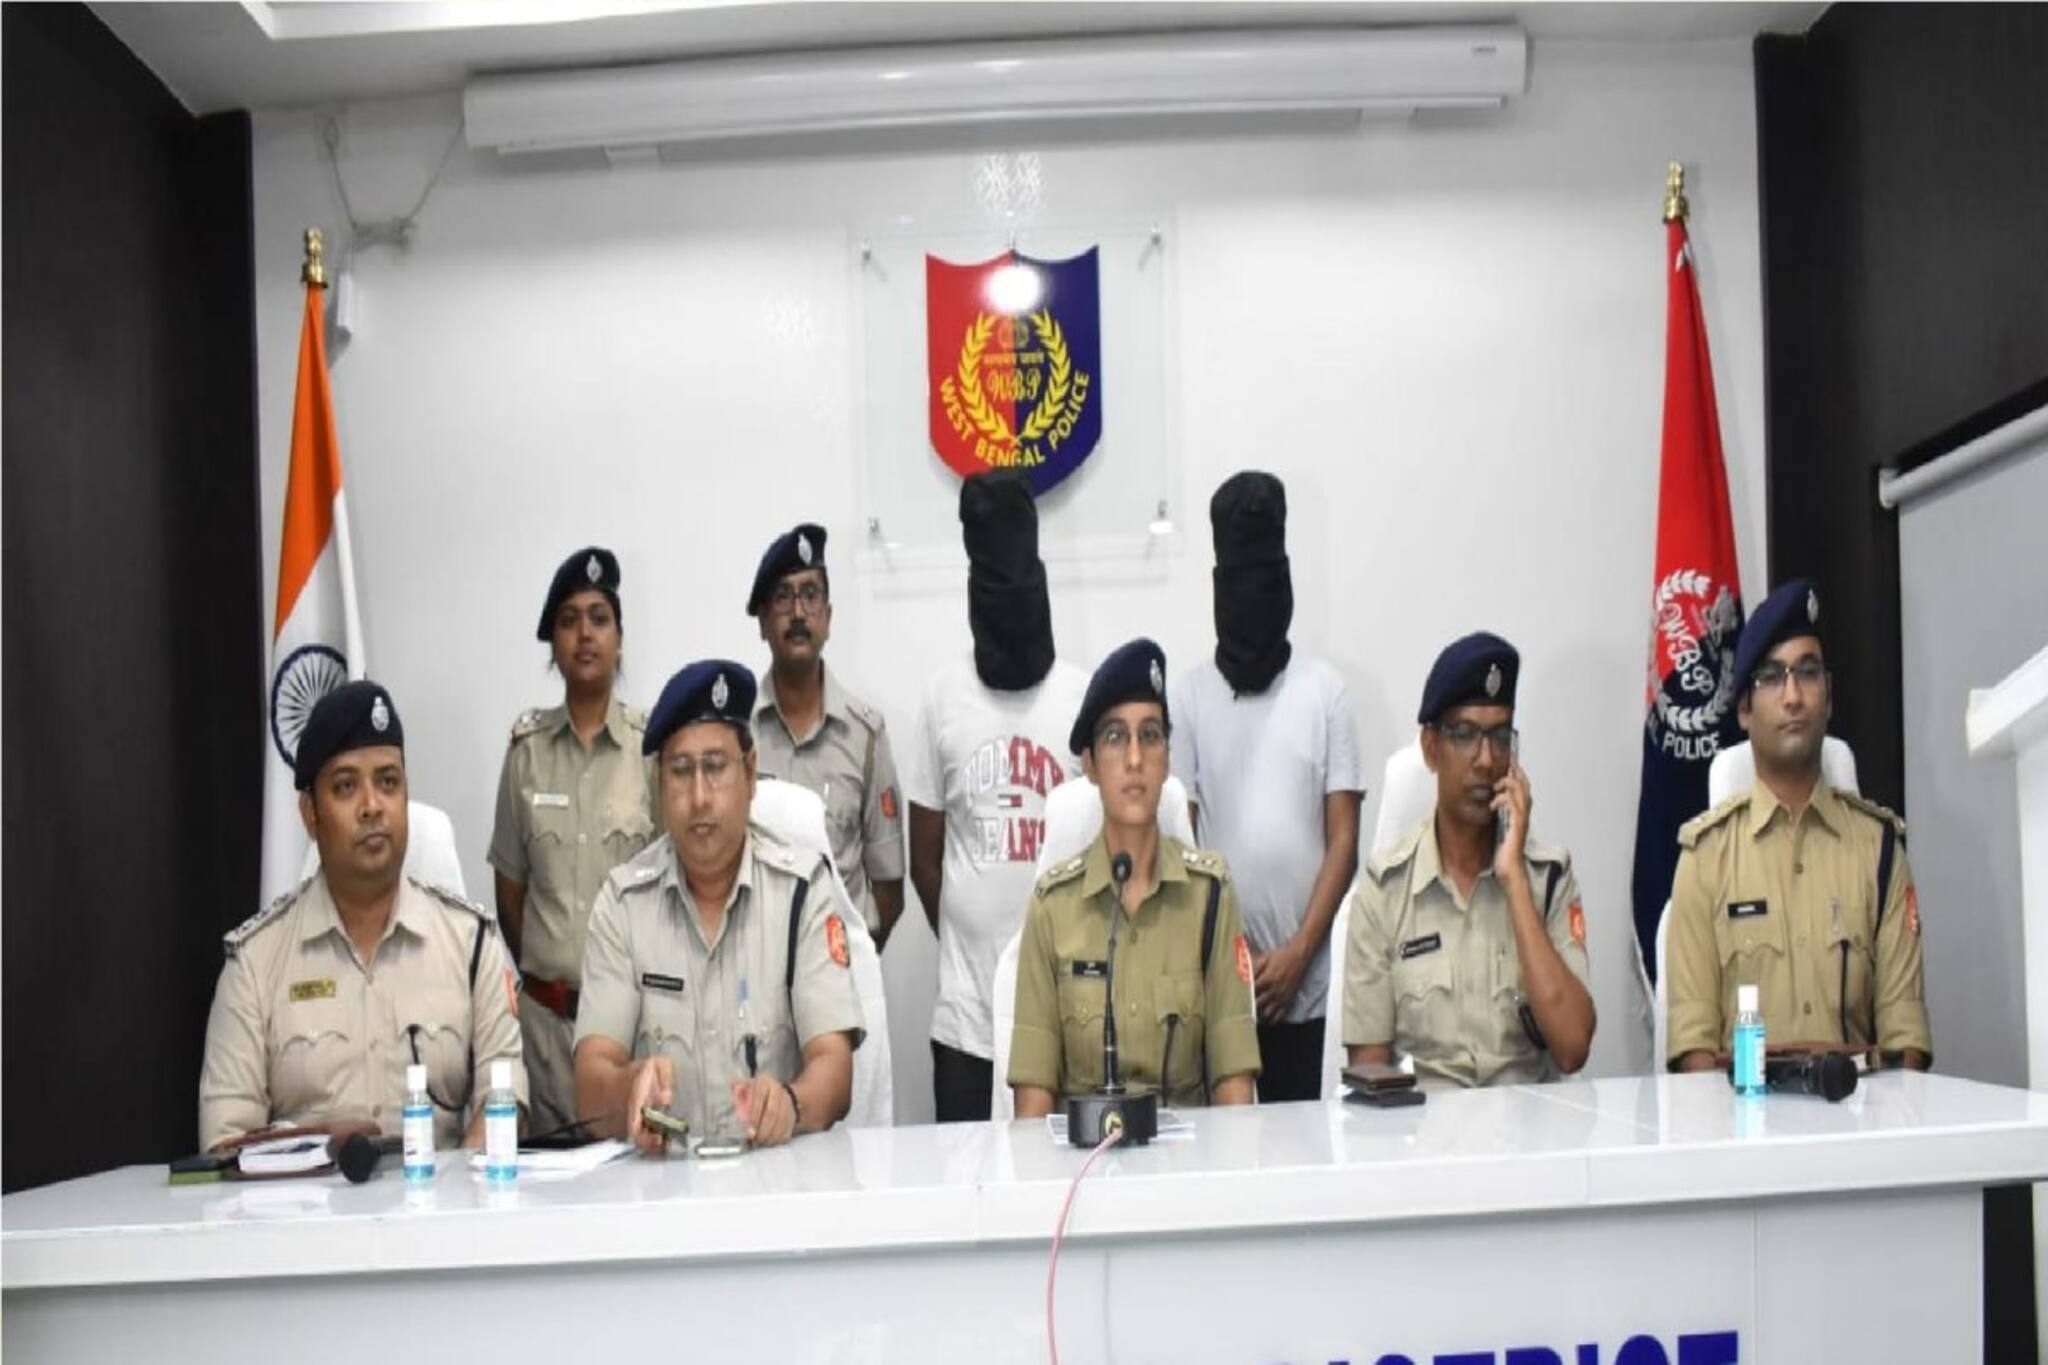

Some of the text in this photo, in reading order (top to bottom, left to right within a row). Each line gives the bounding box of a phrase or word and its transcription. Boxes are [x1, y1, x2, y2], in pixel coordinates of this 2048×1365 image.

[939, 370, 1090, 467] WEST BENGAL POLICE
[1661, 730, 1720, 760] POLICE
